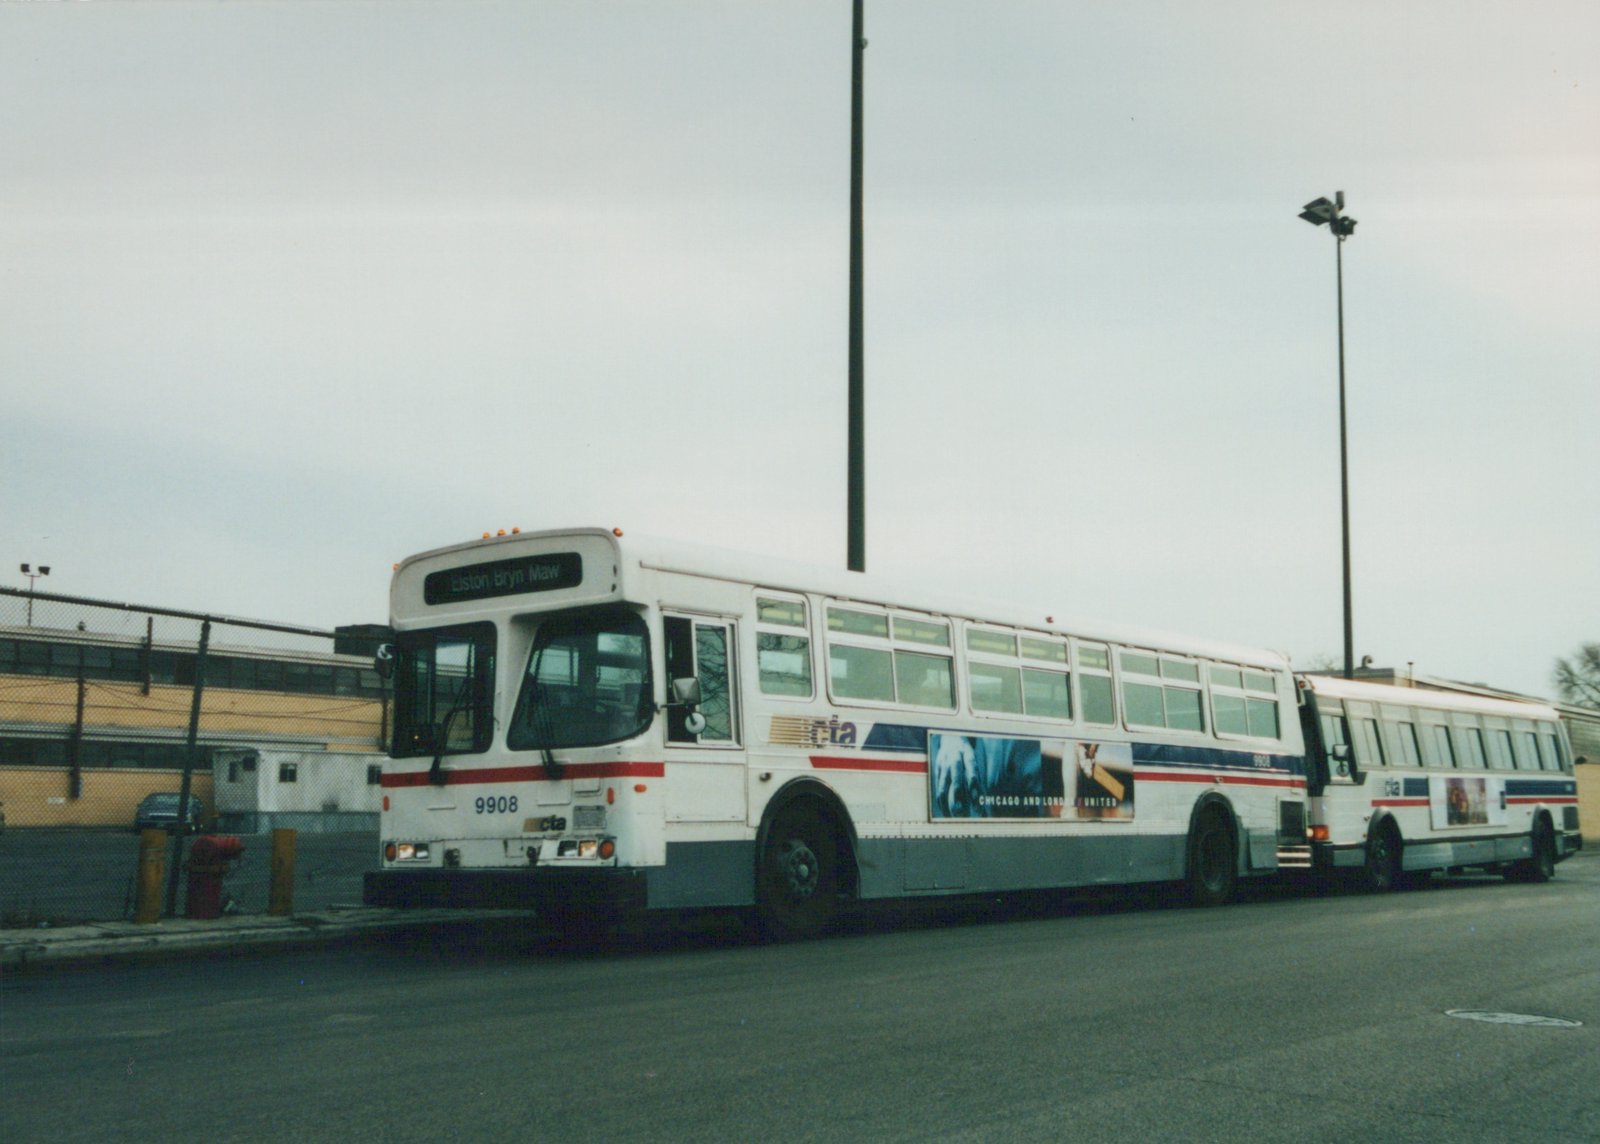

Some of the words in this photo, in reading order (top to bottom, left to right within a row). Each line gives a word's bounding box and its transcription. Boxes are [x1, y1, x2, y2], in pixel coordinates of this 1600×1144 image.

[451, 573, 489, 592] Elston
[495, 569, 524, 588] Bryn
[530, 564, 560, 583] Maw
[475, 796, 518, 814] 9908
[979, 796, 1020, 806] CHICAGO
[1023, 796, 1040, 806] AND
[1043, 796, 1075, 807] LOND
[1084, 797, 1117, 807] UNITED
[540, 815, 567, 831] cta
